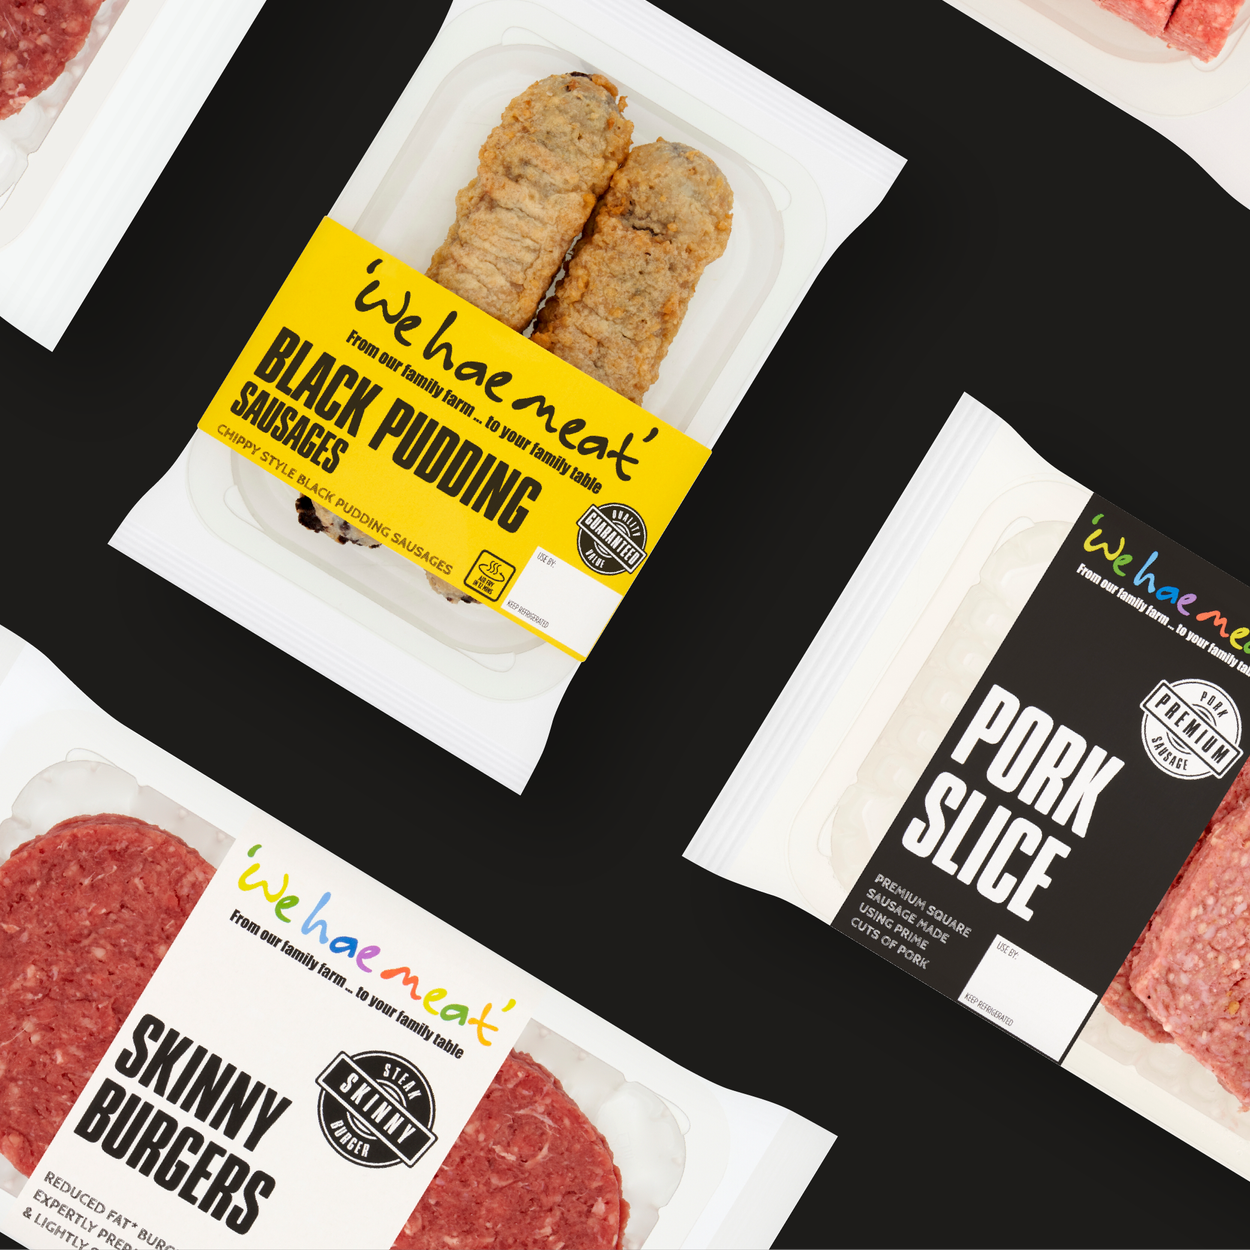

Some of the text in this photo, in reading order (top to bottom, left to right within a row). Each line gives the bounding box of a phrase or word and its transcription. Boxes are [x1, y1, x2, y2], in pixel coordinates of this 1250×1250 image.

[422, 310, 513, 403] hae
[229, 380, 350, 474] SAUSAGES
[253, 326, 543, 534] BLACK PUDDING
[217, 423, 454, 576] CHIPPY STYLE BLACK PUDDING SAUSAGES
[612, 509, 641, 537] QUALITY
[584, 511, 640, 565] GUARANTEED
[585, 548, 605, 569] VALUE
[1133, 550, 1198, 617] hae
[1154, 692, 1230, 764] PREMIUM
[1199, 690, 1229, 718] PORK
[950, 684, 1125, 839] PORK
[1151, 736, 1188, 771] SAUSAGE
[901, 771, 1072, 922] SLICE
[301, 891, 381, 973] hae
[859, 902, 930, 951] USING PRIME
[866, 888, 950, 944] SAUSAGE MADE
[874, 873, 972, 938] PREMIUM SQUARE
[851, 917, 930, 970] CUTS OF PORK
[114, 1013, 293, 1153] SKINNY
[339, 1072, 417, 1144] SKINNY
[383, 1063, 422, 1100] STEAK
[73, 1077, 276, 1236] BURGERS
[330, 1119, 370, 1158] BURGER
[32, 1188, 98, 1233] EXPERTLY
[43, 1170, 106, 1214] REDUCED
[33, 1212, 90, 1250] LIGHTLY
